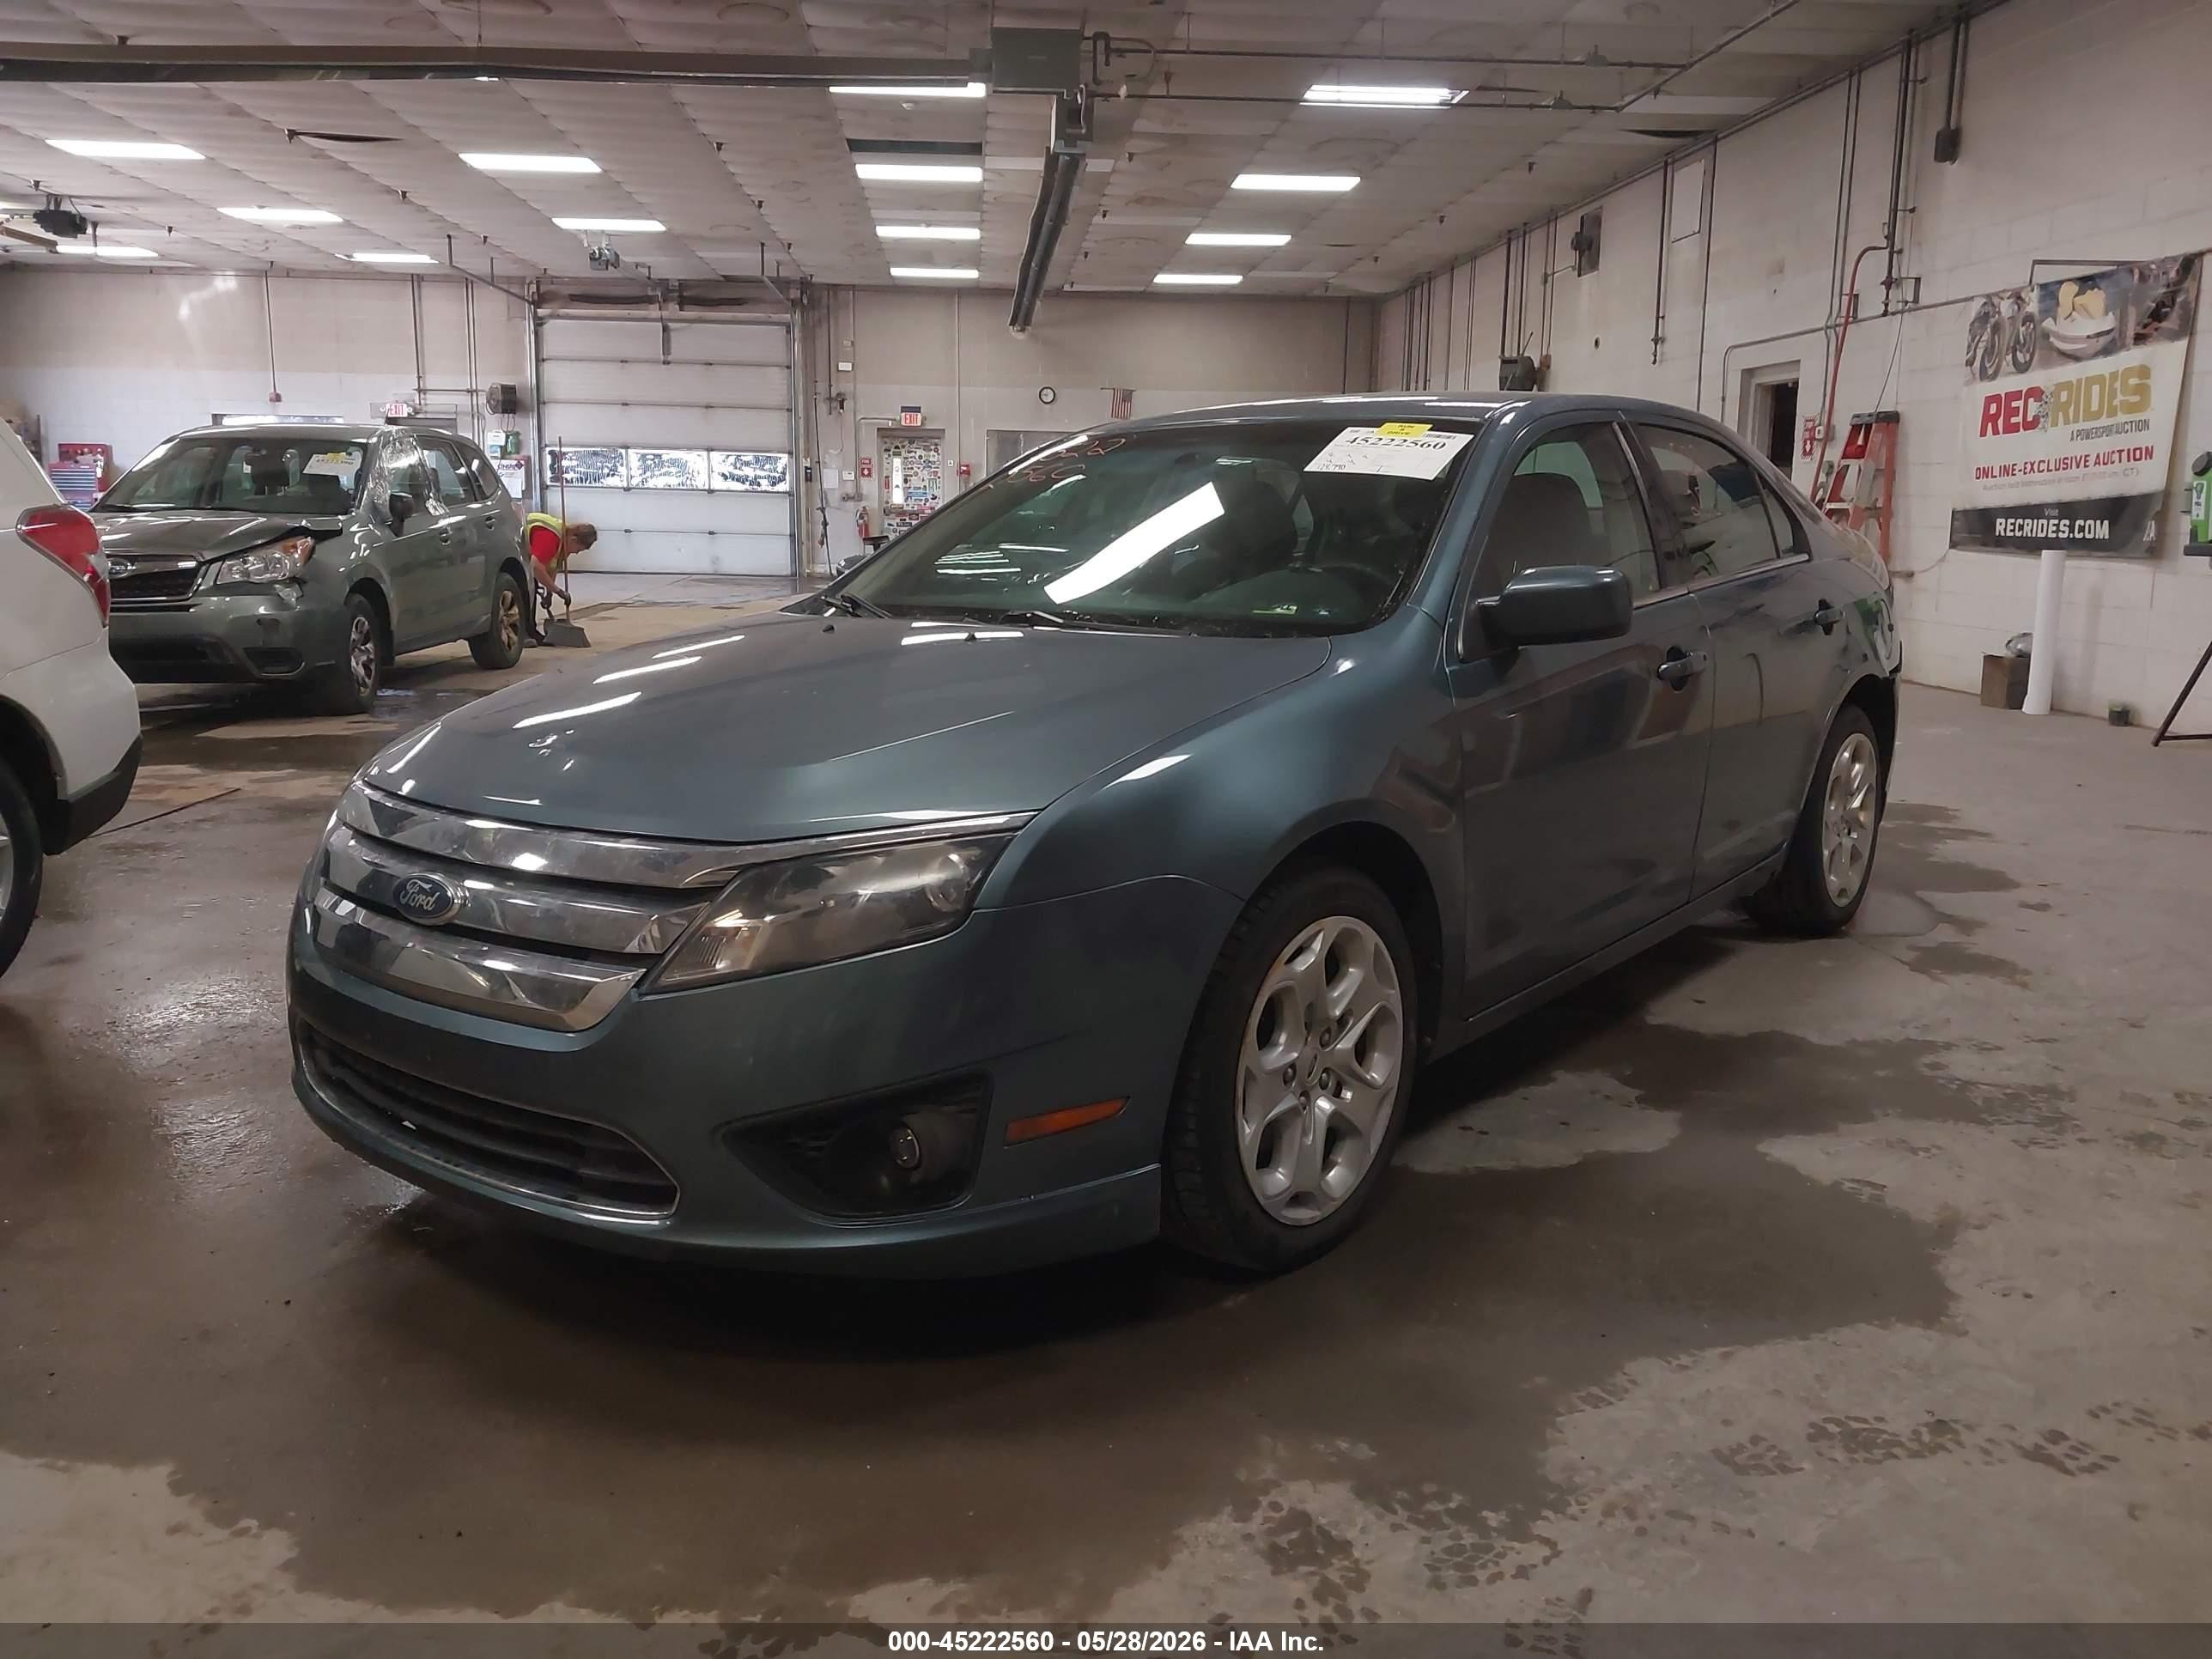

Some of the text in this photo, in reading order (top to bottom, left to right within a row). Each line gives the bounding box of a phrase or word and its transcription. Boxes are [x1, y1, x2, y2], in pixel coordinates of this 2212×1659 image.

[389, 404, 404, 416] EXIT
[1979, 363, 2152, 438] REC RIDES
[904, 413, 919, 425] EXIT
[1346, 435, 1447, 451] 45222560
[1975, 453, 2091, 481] ONLINE-EXCLUSIVE
[2094, 445, 2154, 467] AUCTION
[1996, 518, 2110, 539] RECRIDES.COM
[399, 879, 441, 911] Ford
